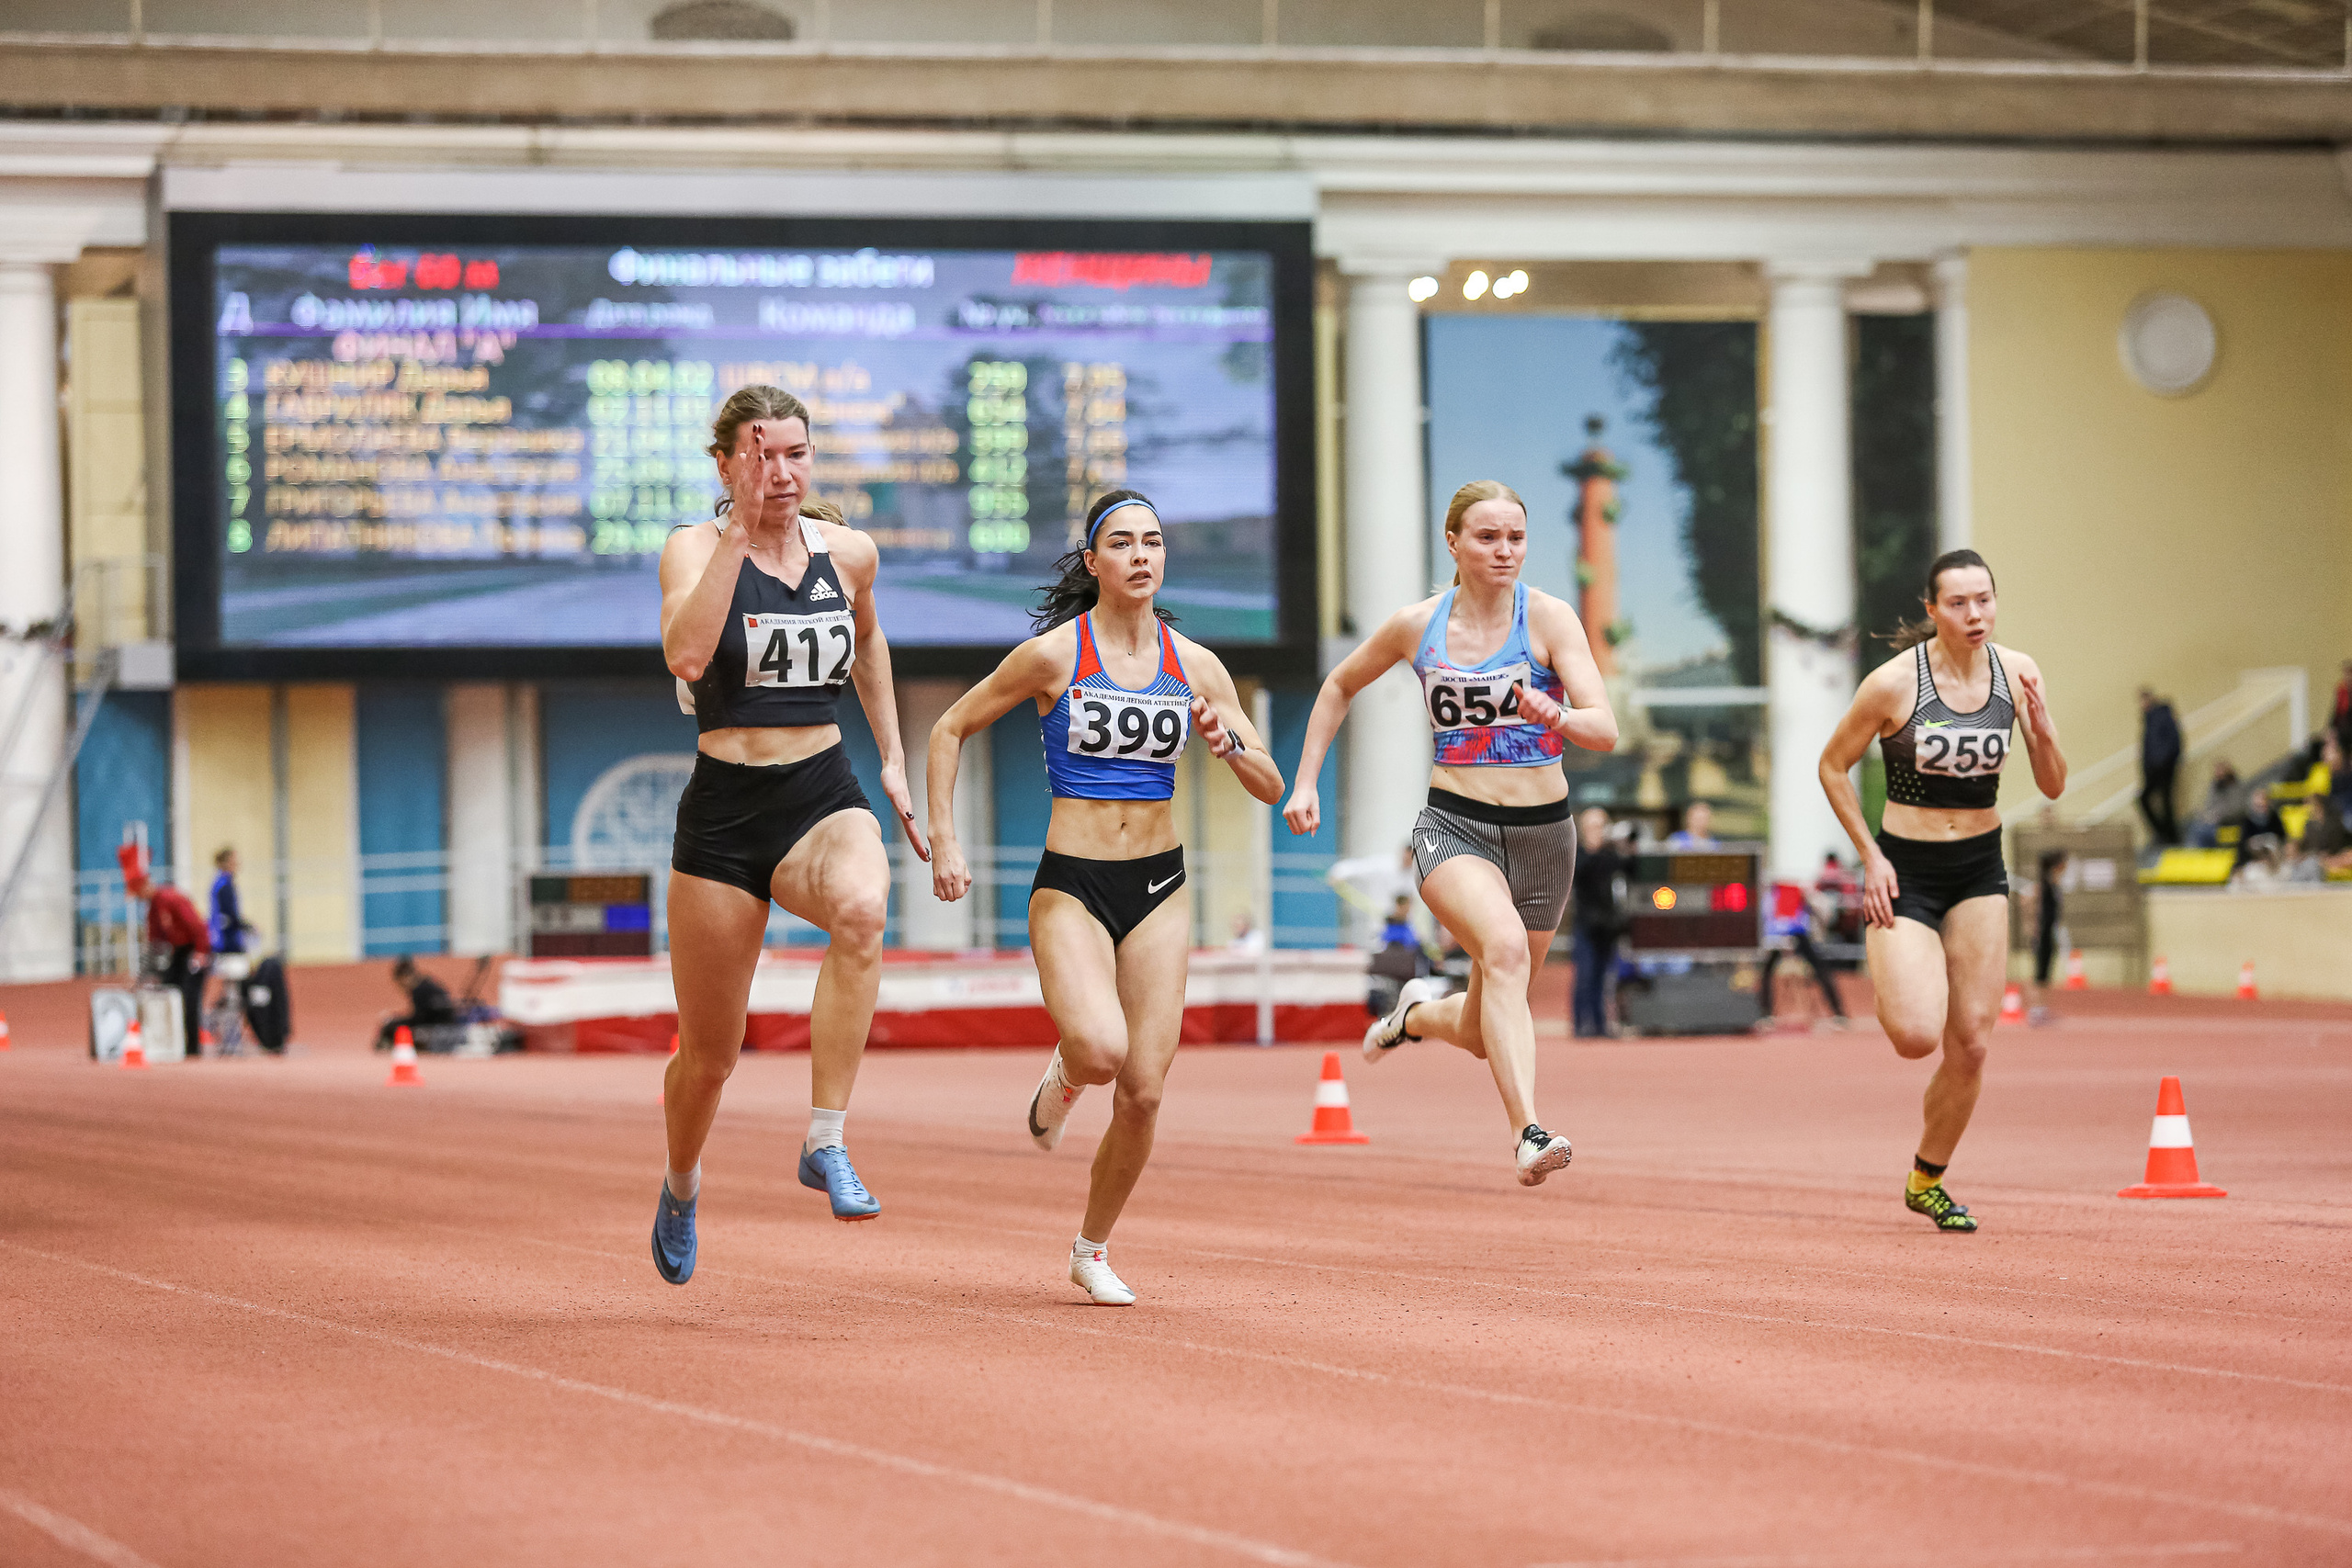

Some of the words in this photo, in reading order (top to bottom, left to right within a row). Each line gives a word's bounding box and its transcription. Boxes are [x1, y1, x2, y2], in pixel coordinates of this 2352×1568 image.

[809, 591, 838, 602] adidas
[797, 616, 824, 626] ЛЕГКОЙ
[759, 625, 852, 682] 412
[1083, 691, 1125, 703] АКАДЕМИЯ
[1125, 697, 1152, 705] ЛЕГКОЙ
[1430, 679, 1527, 727] 654
[1079, 701, 1181, 758] 399
[1922, 734, 2005, 773] 259
